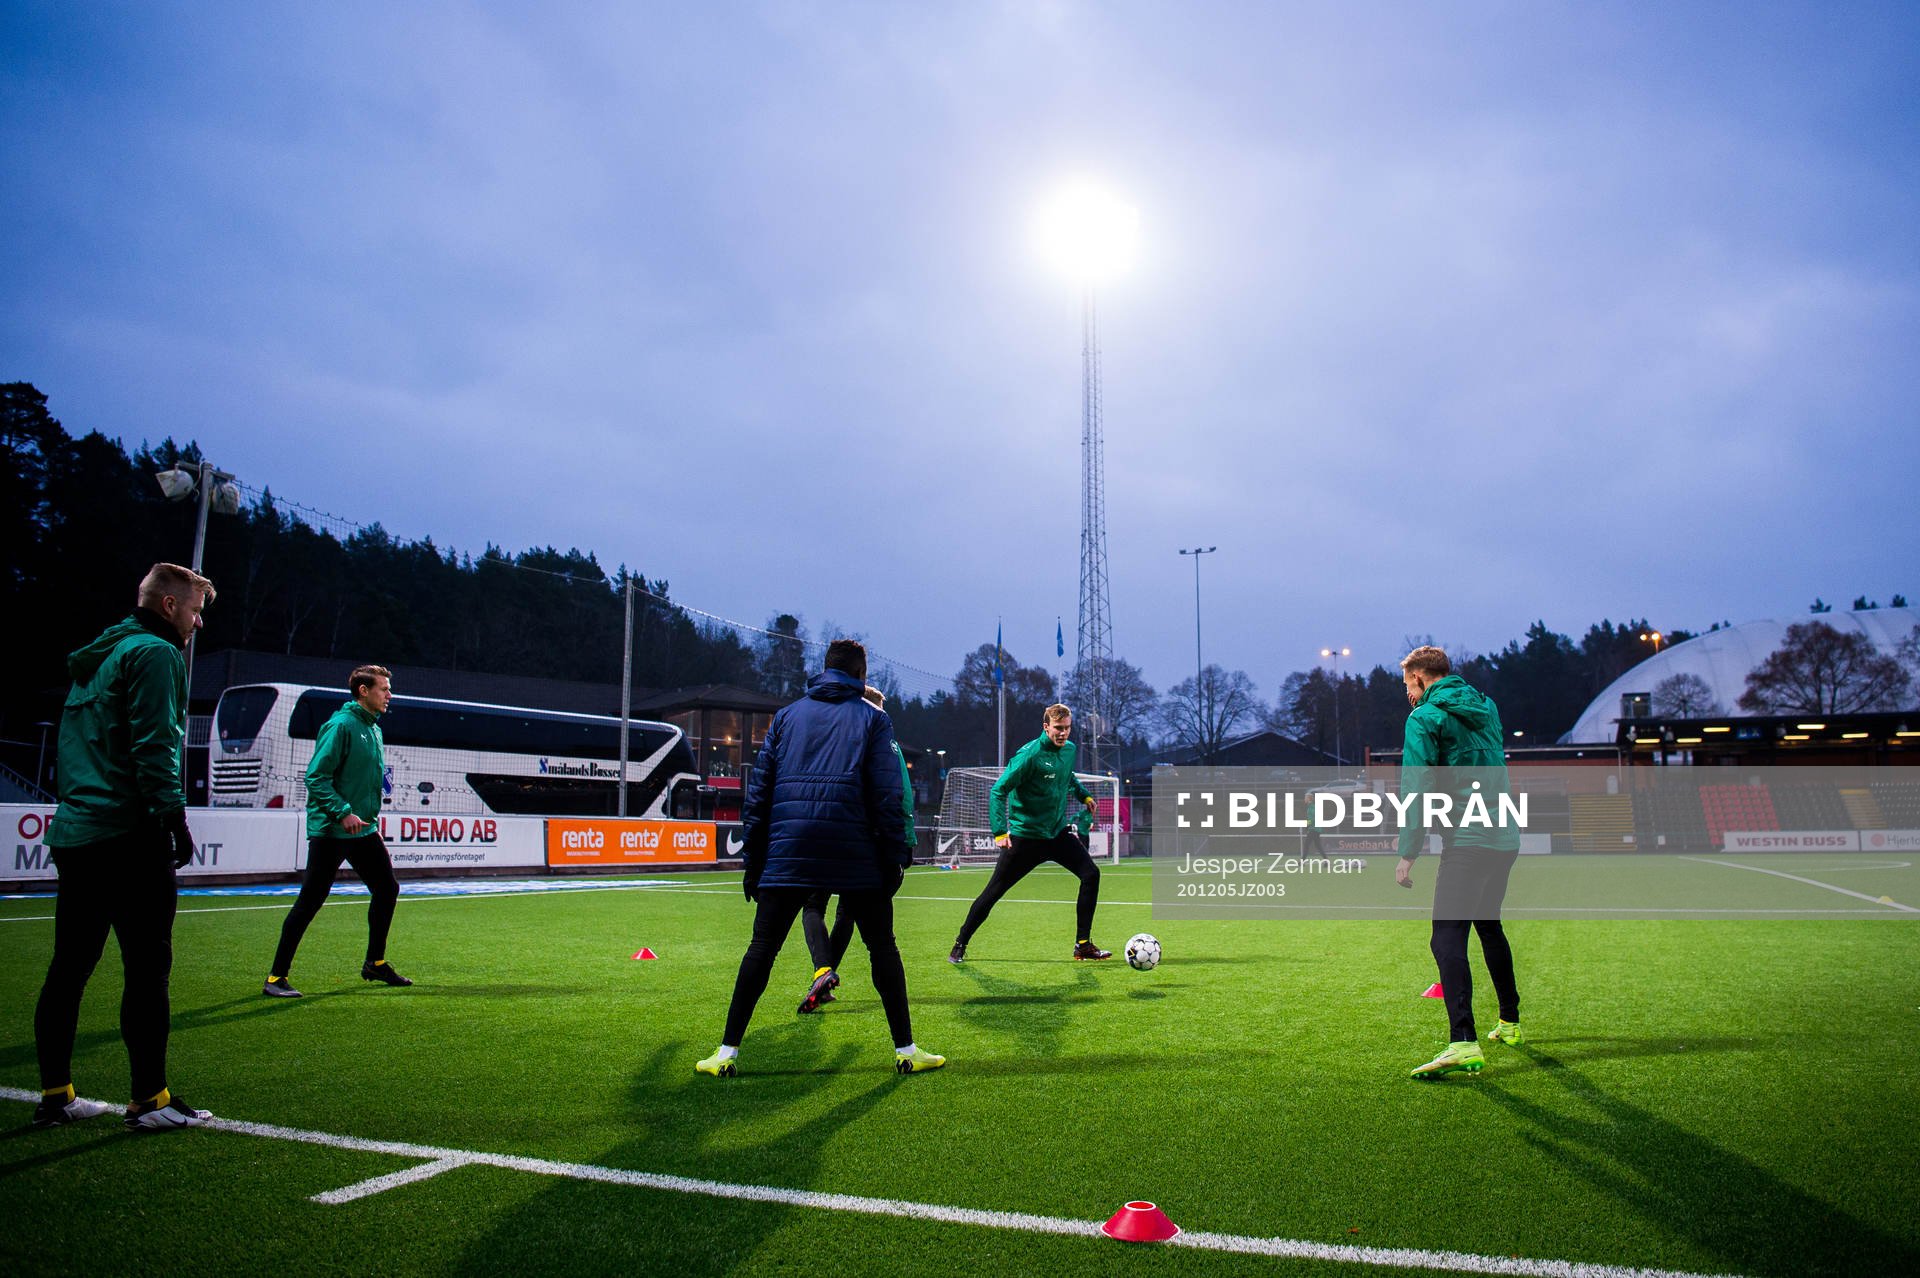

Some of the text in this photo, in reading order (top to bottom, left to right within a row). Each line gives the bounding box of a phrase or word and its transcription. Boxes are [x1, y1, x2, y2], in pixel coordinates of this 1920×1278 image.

[400, 817, 464, 843] DEMO
[470, 818, 498, 843] AB
[562, 828, 605, 848] renta
[620, 828, 659, 848] renta
[673, 829, 707, 848] renta
[1338, 840, 1390, 850] Swedbank
[1737, 836, 1847, 847] WESTIN BUSS
[394, 852, 424, 863] smidiga
[425, 852, 485, 863] rivningsföretaget
